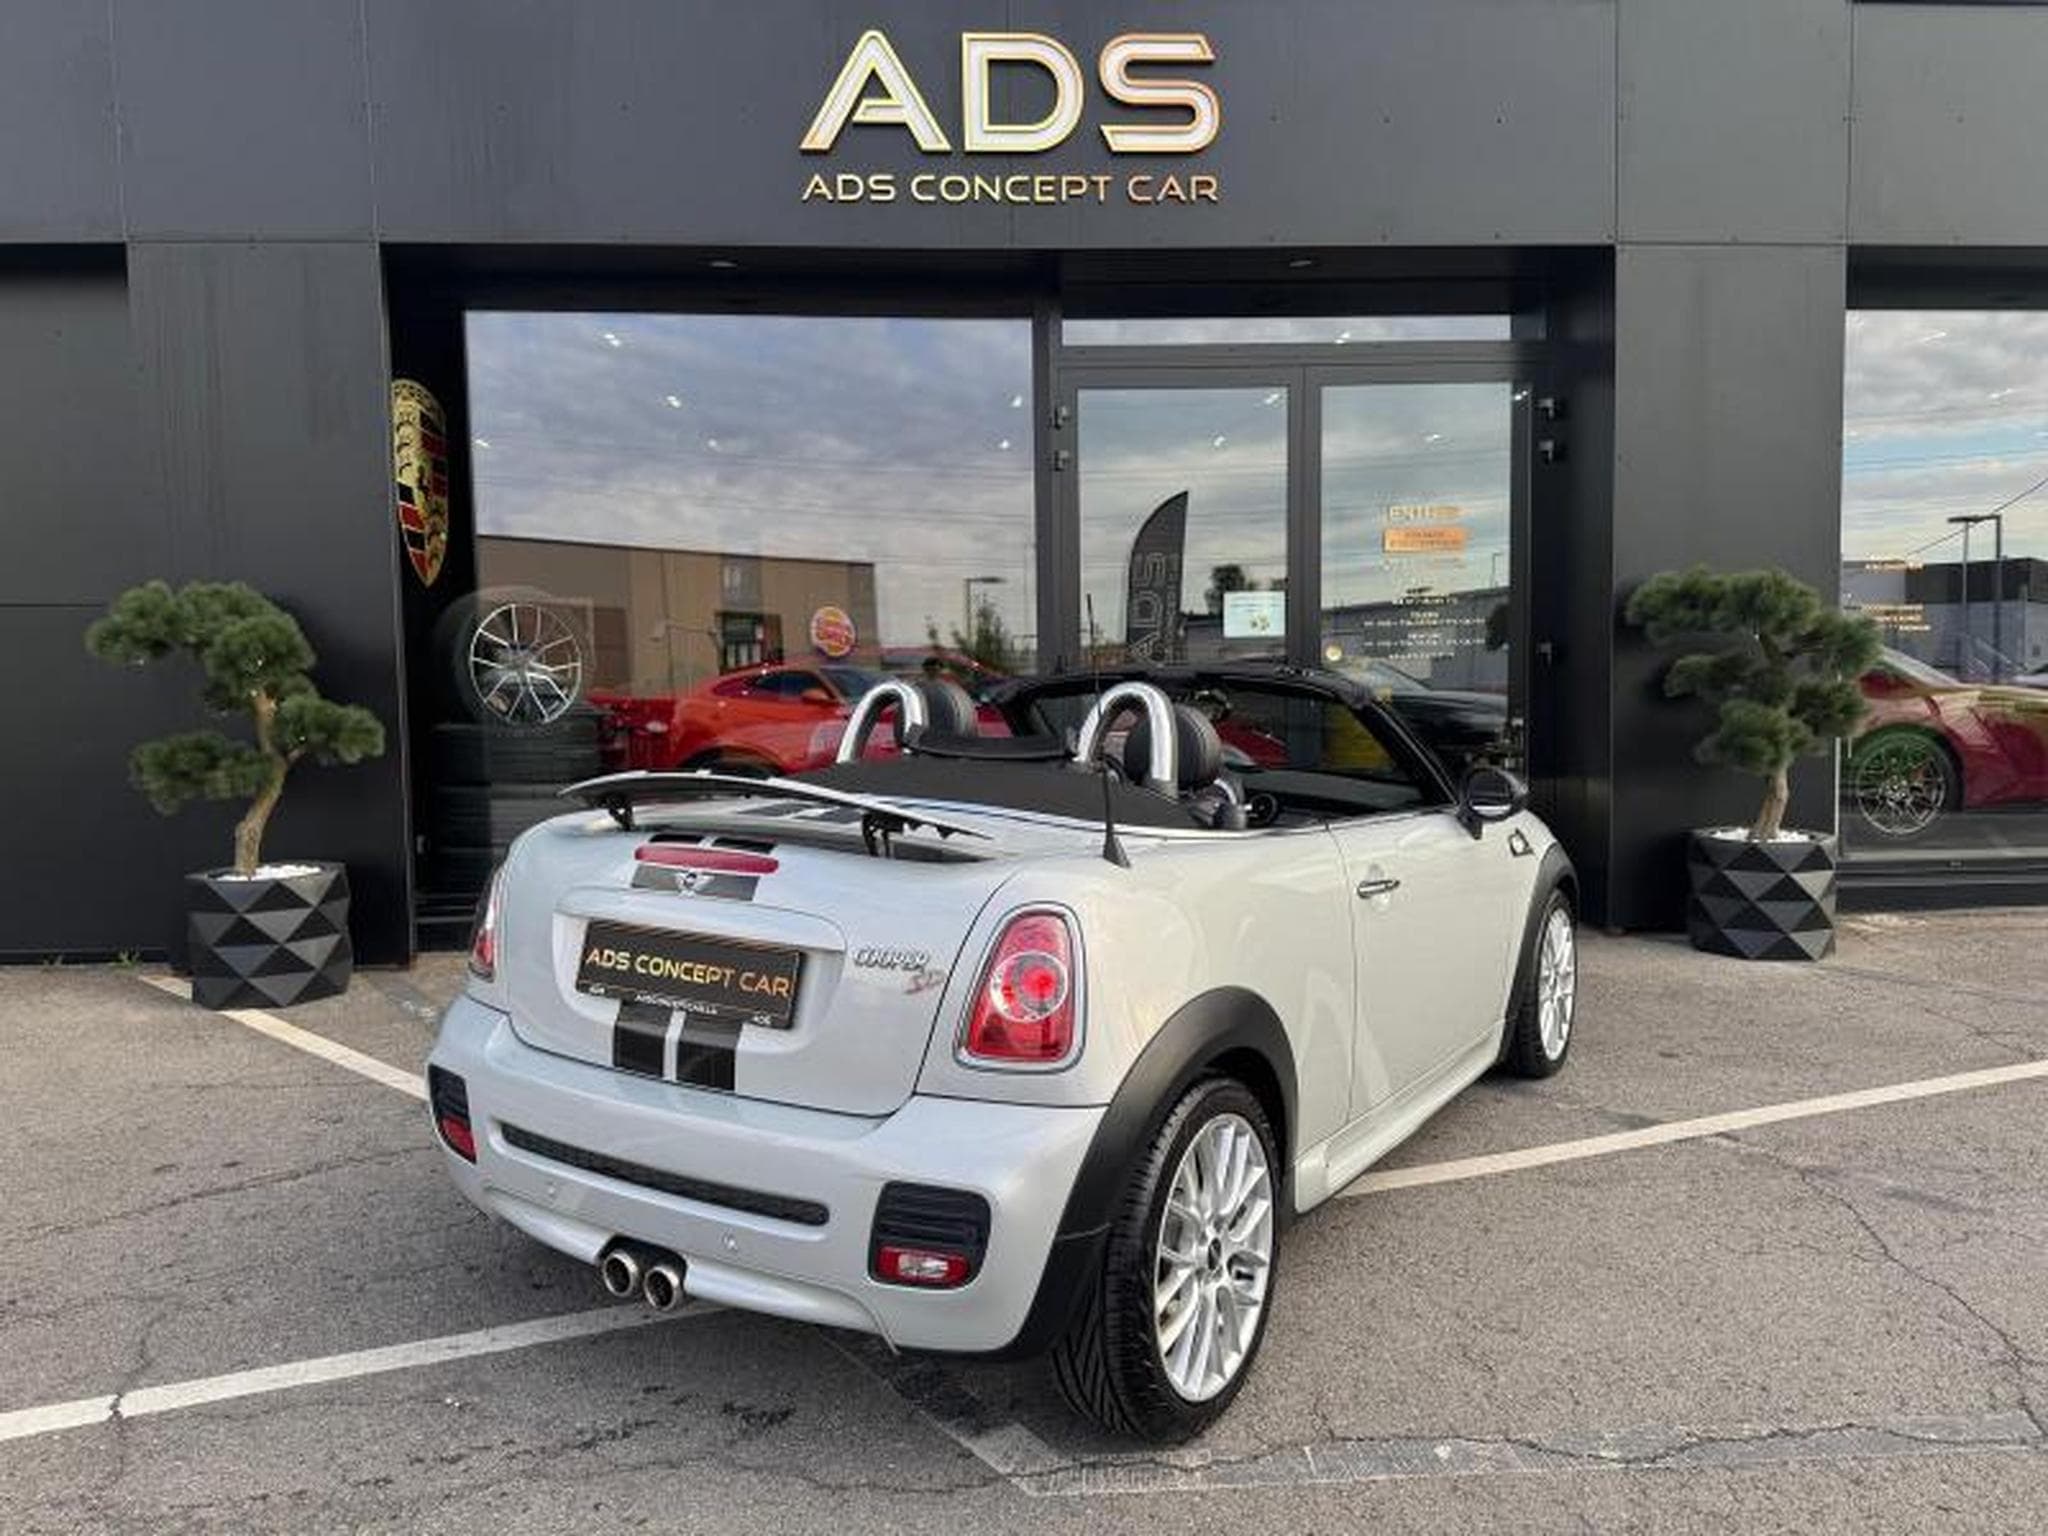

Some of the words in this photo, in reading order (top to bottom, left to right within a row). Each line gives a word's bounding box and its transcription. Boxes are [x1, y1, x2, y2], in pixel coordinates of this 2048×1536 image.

[800, 30, 1220, 152] ADS
[802, 174, 896, 201] ADS
[910, 174, 1112, 202] CONCEPT
[1127, 174, 1219, 203] CAR
[585, 947, 630, 971] ADS
[634, 955, 735, 988] CONCEPT
[738, 972, 790, 999] CAR
[854, 947, 931, 973] COOPER
